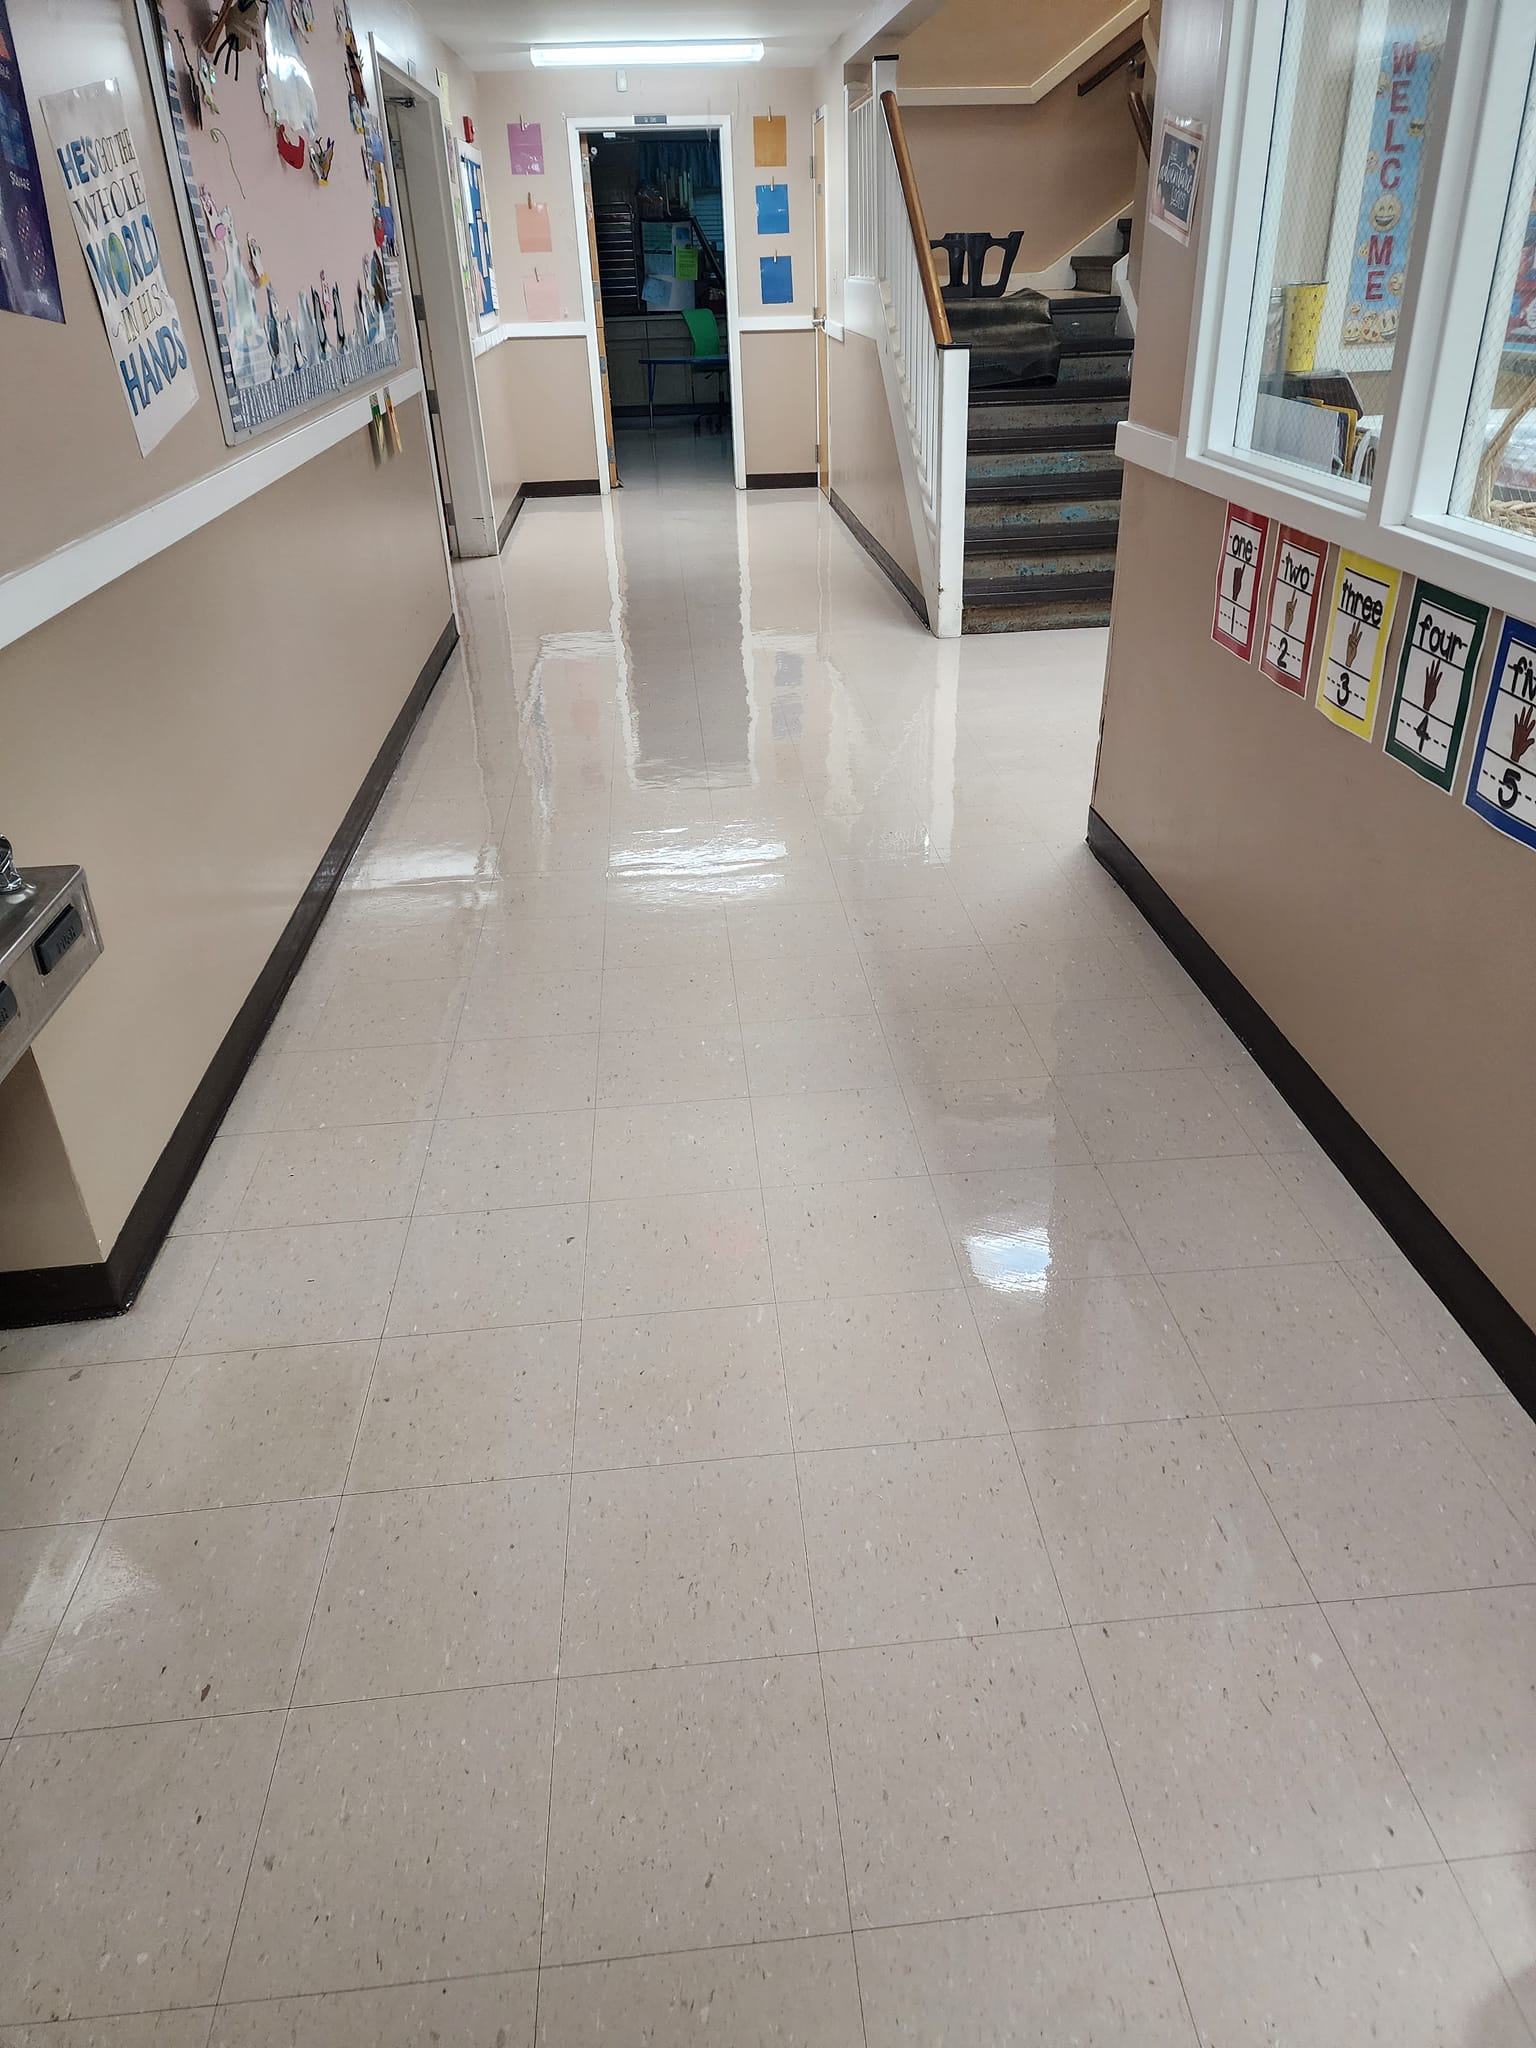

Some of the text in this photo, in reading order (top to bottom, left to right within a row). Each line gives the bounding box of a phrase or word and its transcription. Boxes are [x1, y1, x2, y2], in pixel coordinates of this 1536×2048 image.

[57, 128, 136, 190] HE'S GOT THE
[73, 170, 146, 235] WHOLE
[86, 213, 160, 306] WORLD
[121, 283, 164, 345] IN HIS
[119, 318, 188, 417] HANDS
[1231, 534, 1253, 562] one
[1284, 551, 1310, 591] two
[1340, 578, 1384, 626] three
[1276, 636, 1289, 670] 2
[1418, 614, 1464, 662] four
[1336, 672, 1351, 707] 3
[1415, 714, 1431, 753] 4
[1497, 767, 1522, 810] 5
